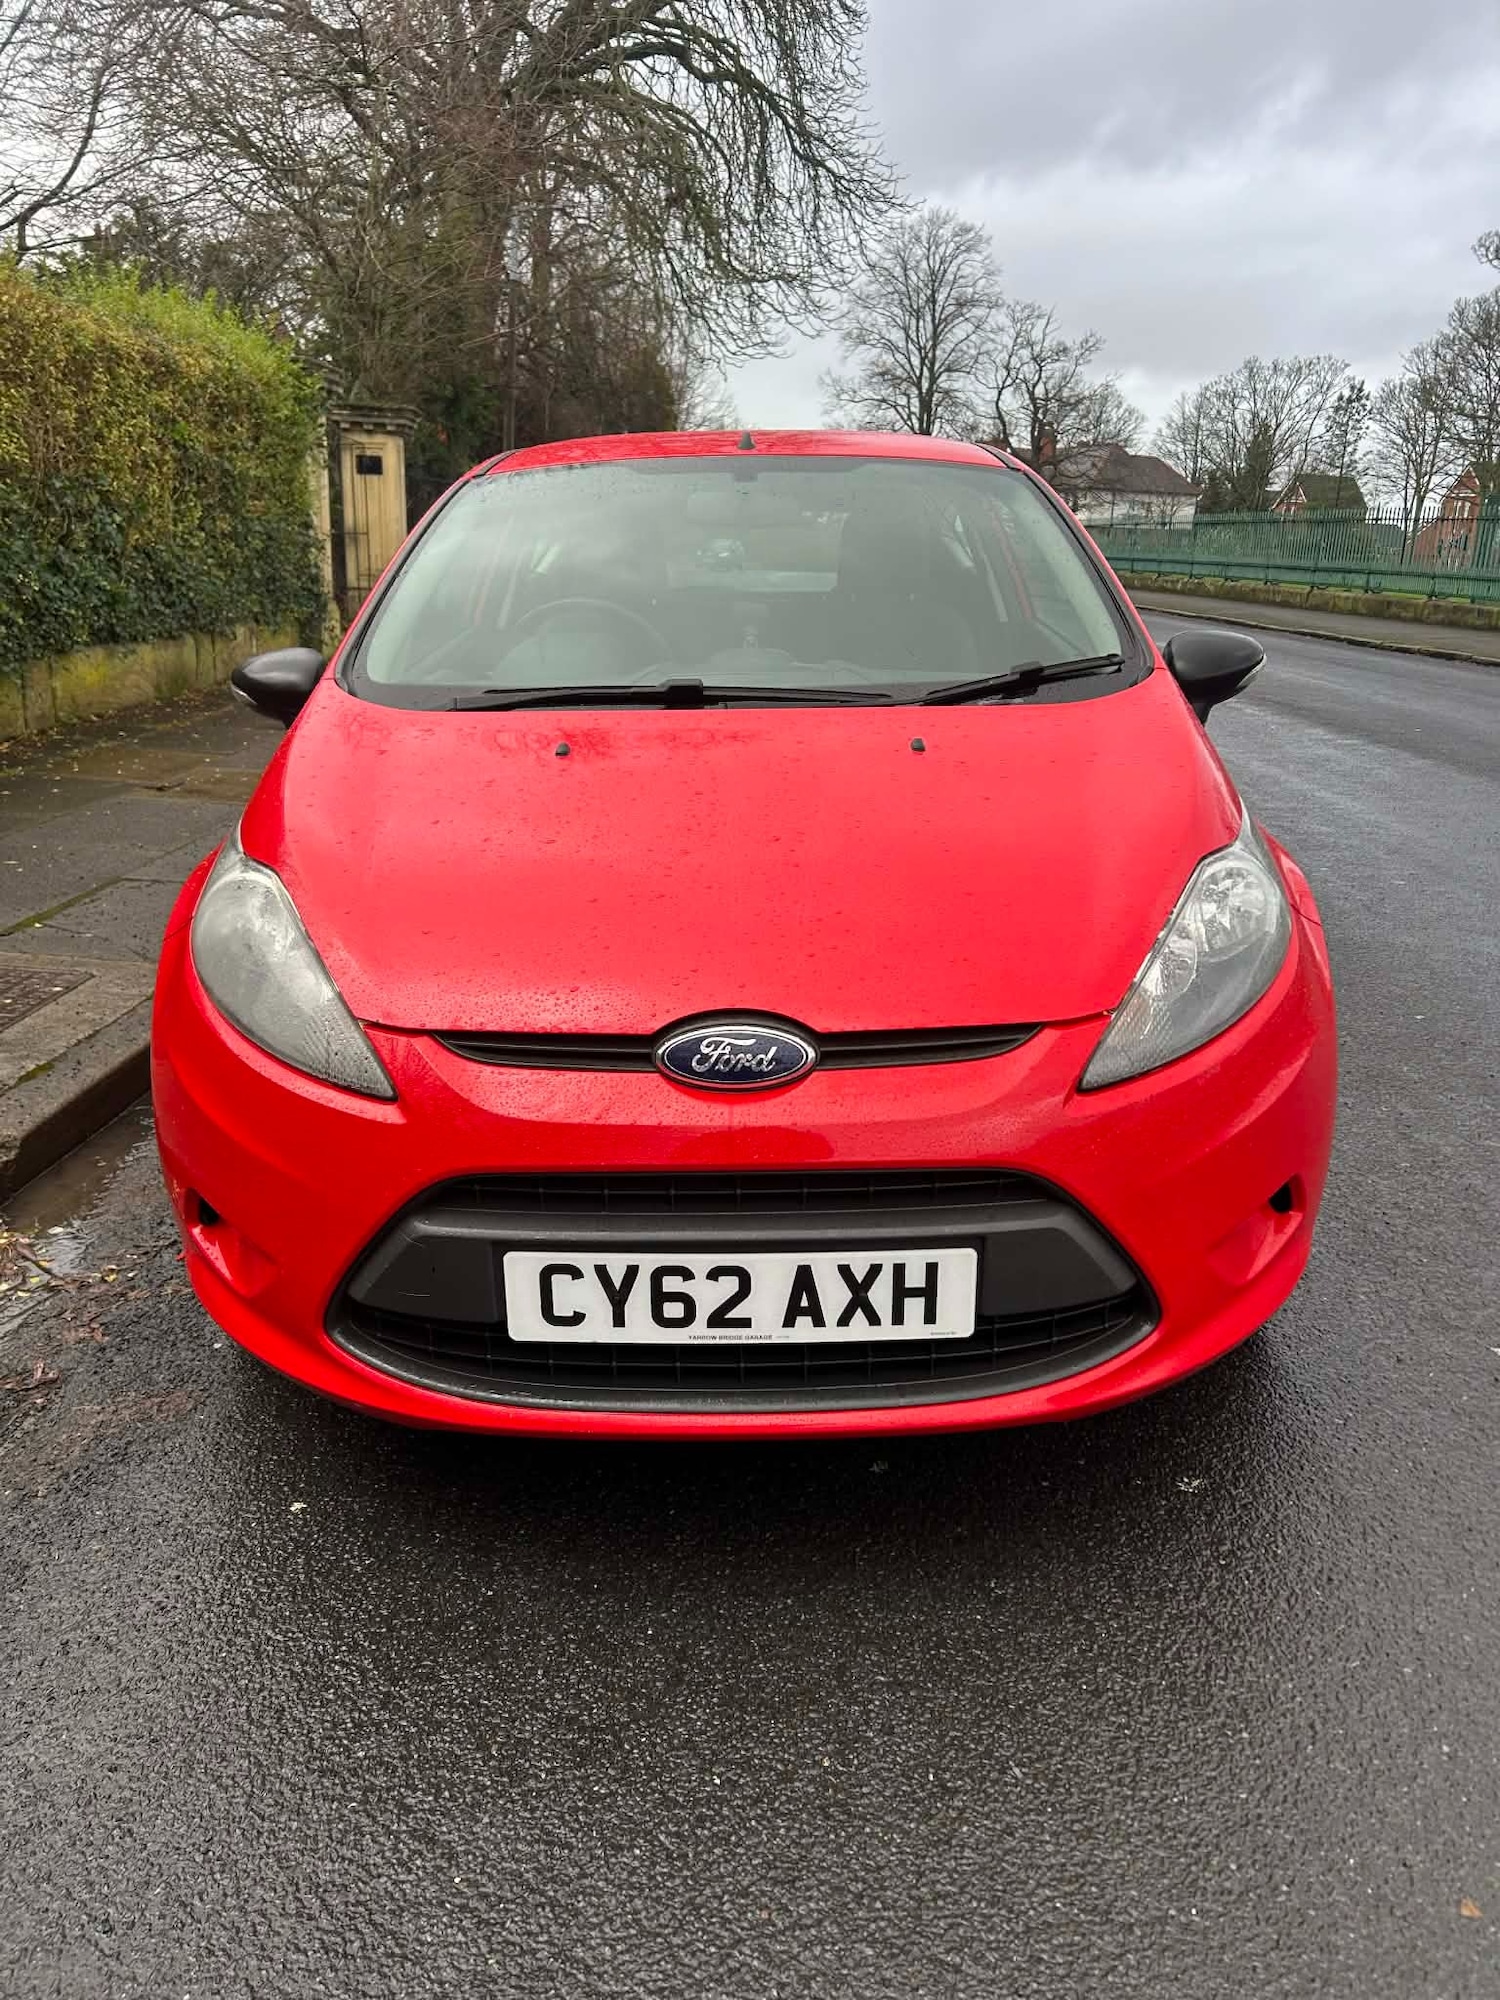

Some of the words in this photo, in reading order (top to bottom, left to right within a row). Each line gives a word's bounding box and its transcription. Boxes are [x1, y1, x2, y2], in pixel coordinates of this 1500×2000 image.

[691, 1036, 777, 1073] Ford
[538, 1263, 752, 1329] CY62
[782, 1261, 939, 1328] AXH
